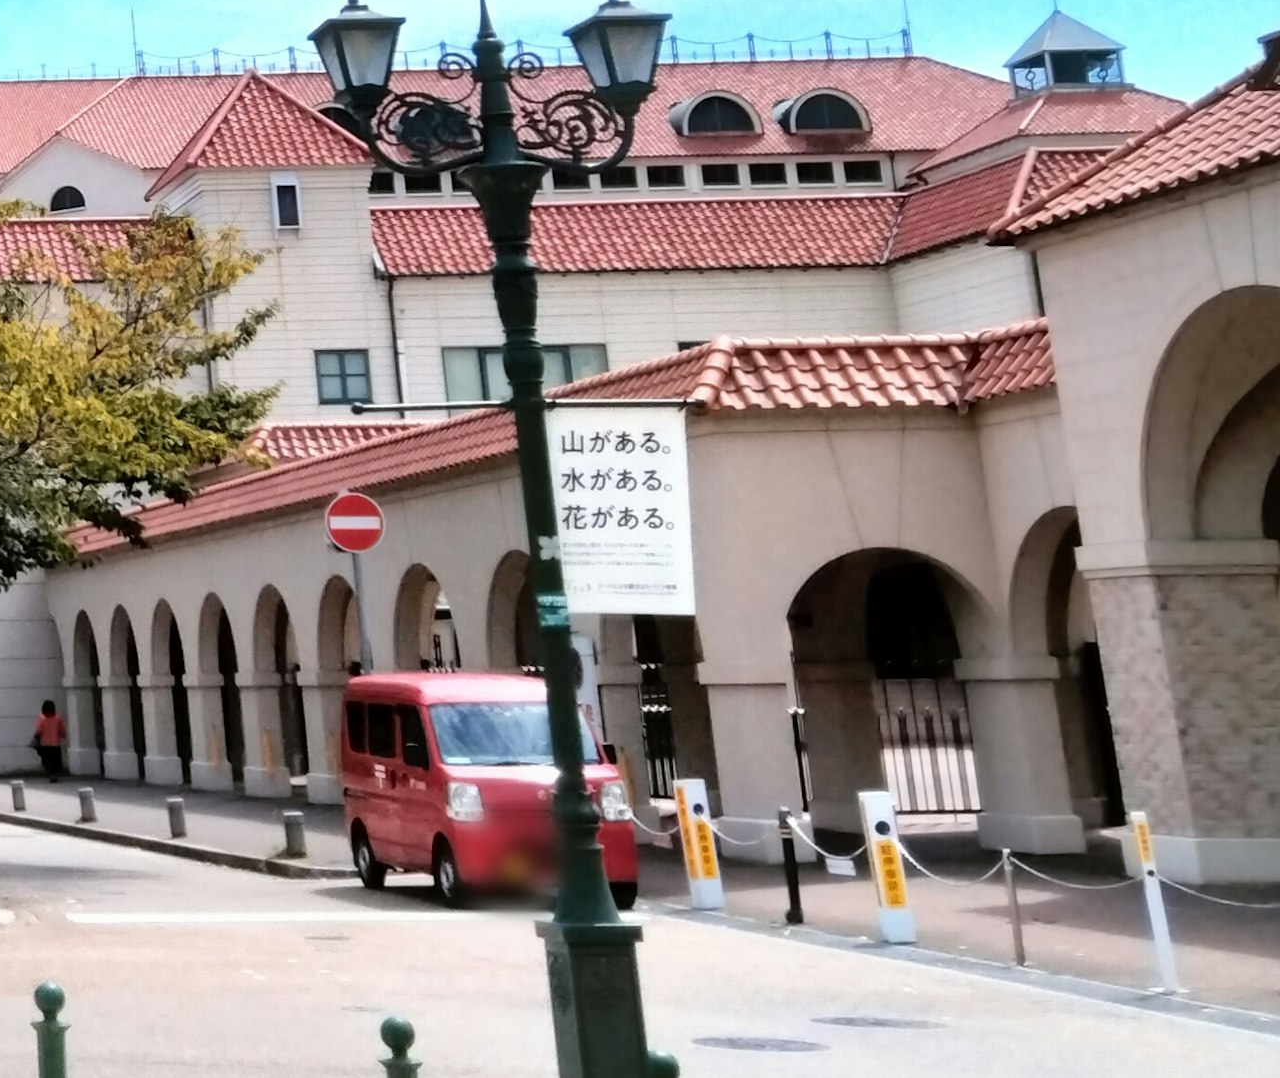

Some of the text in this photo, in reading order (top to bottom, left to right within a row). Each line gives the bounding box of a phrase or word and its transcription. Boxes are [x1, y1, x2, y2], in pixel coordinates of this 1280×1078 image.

[561, 430, 672, 455] 山がある。
[561, 467, 673, 493] 水がある。
[561, 505, 676, 531] 花がある。
